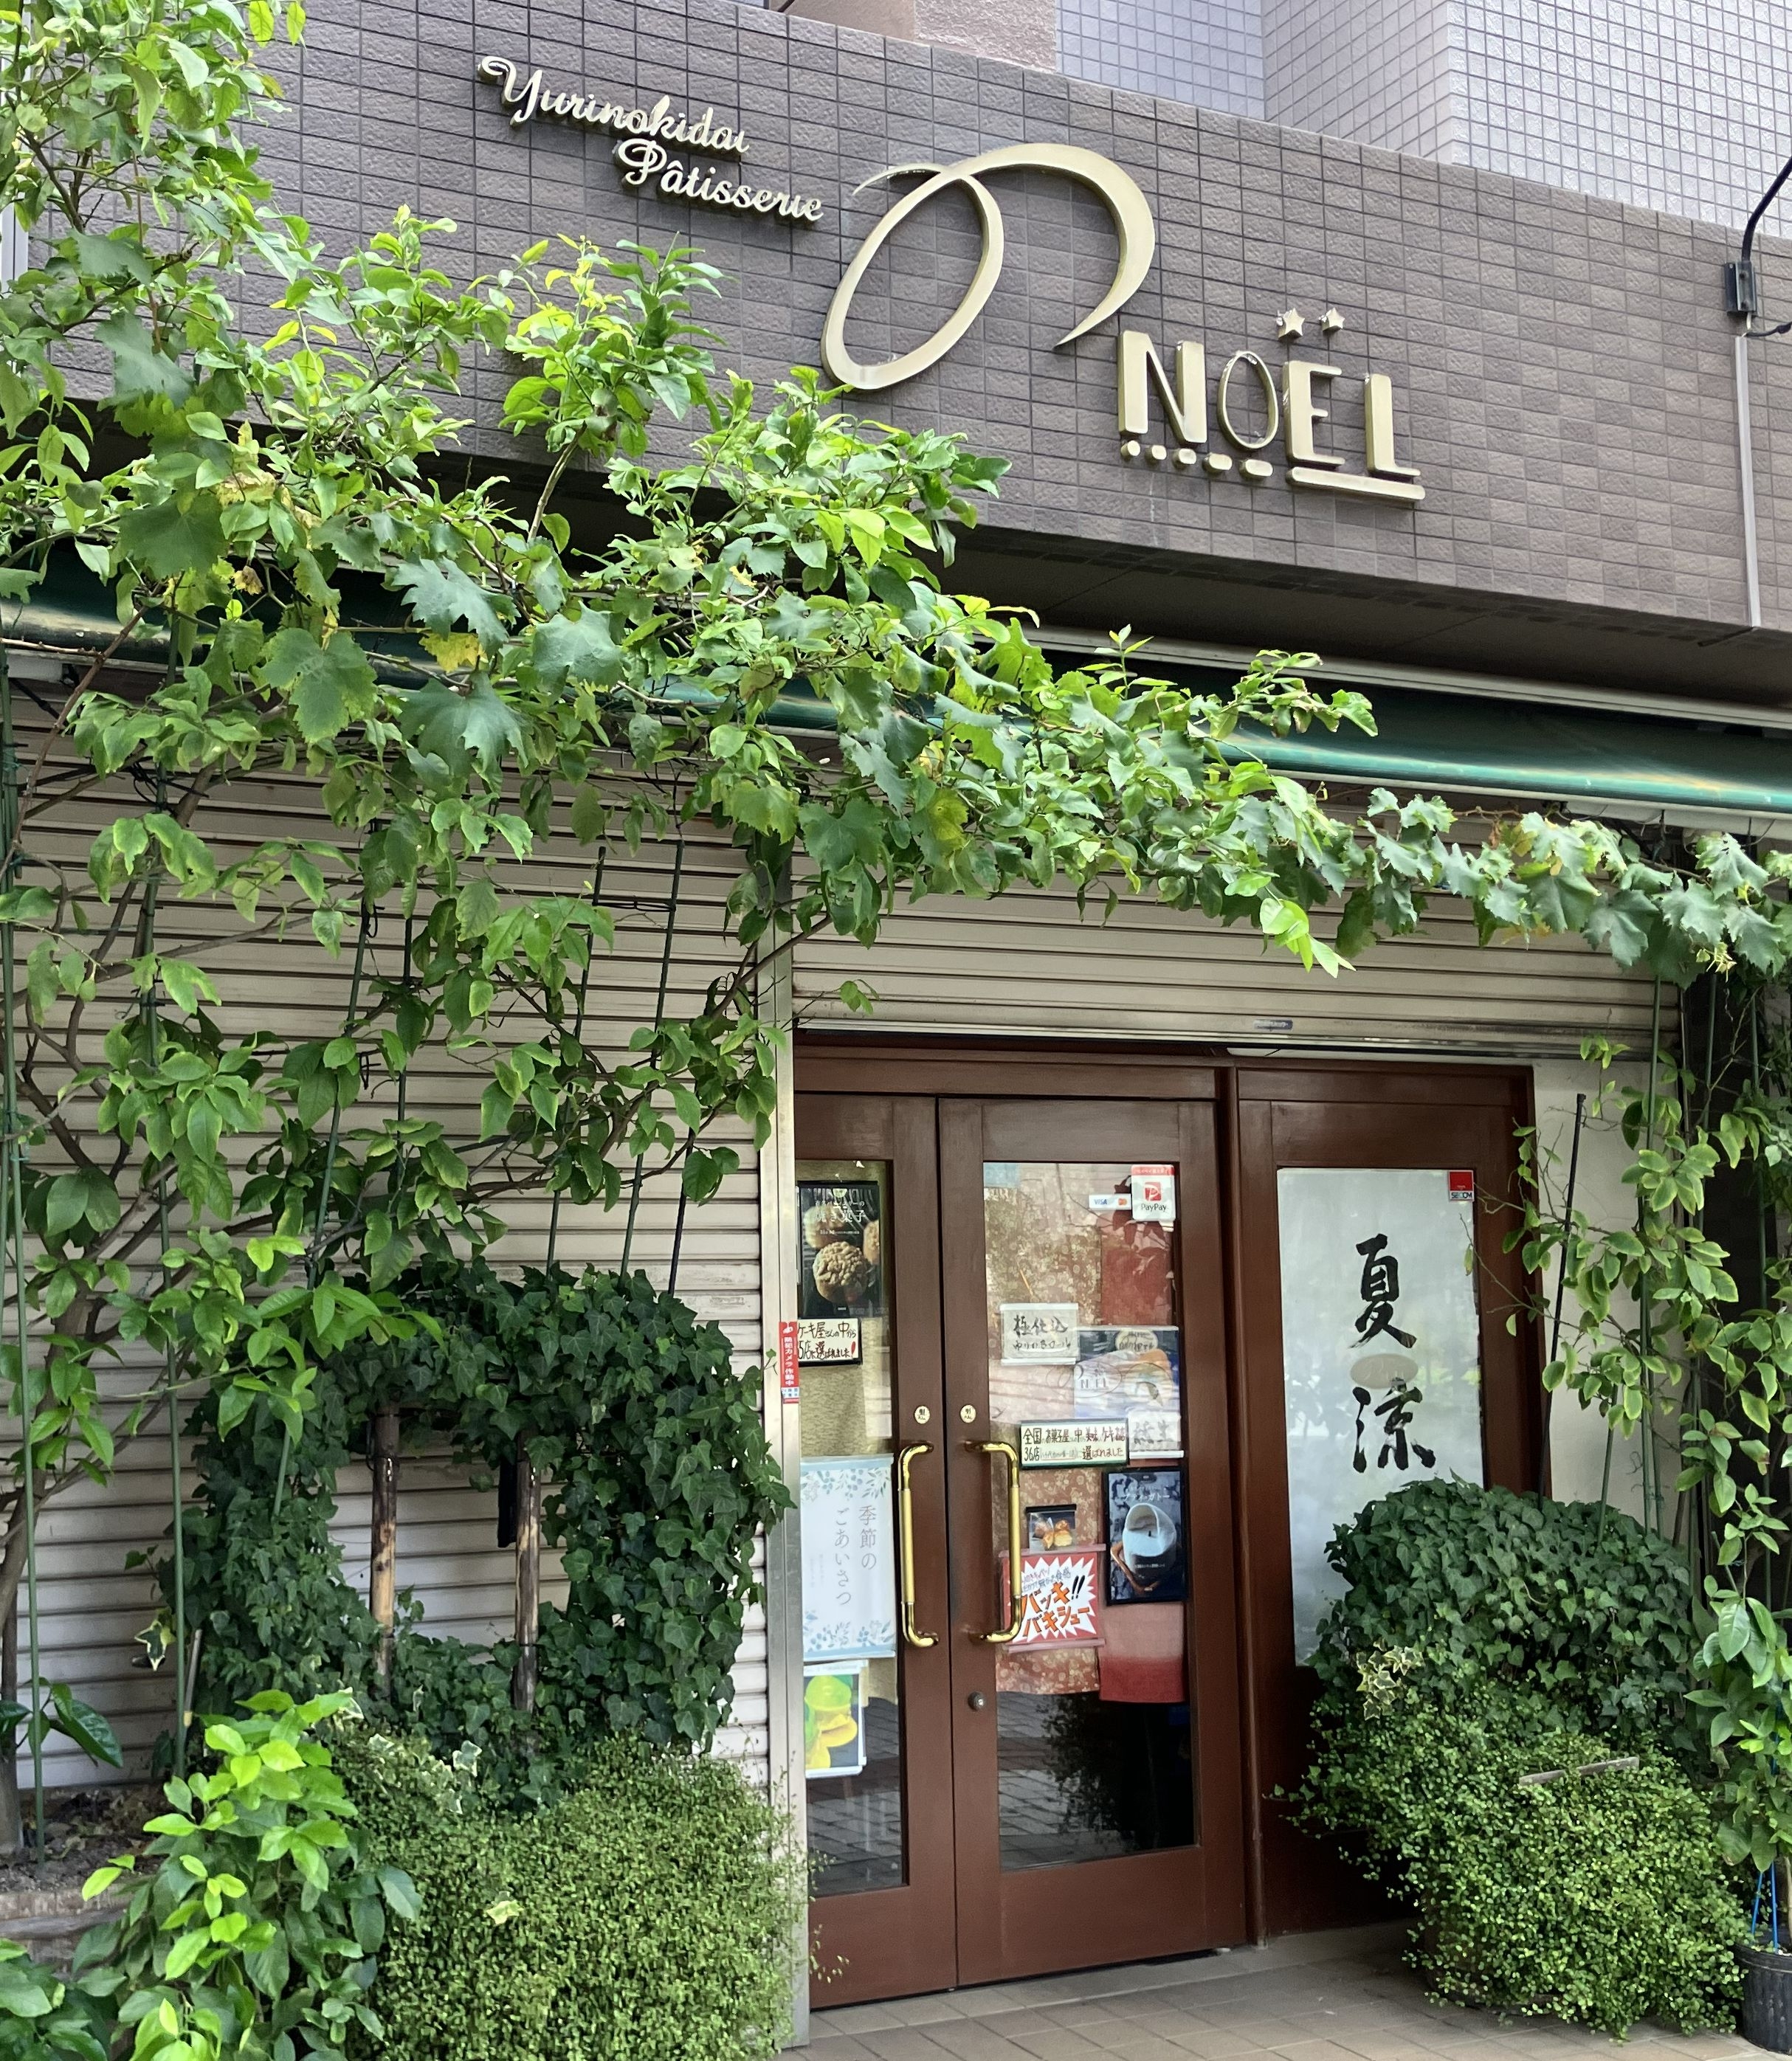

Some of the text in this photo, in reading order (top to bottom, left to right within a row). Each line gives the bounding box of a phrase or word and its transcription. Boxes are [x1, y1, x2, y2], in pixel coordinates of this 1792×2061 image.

[613, 138, 824, 222] Pâtisserie
[1141, 1204, 1167, 1212] PayPay
[834, 1508, 852, 1606] ごあいさつ
[858, 1505, 877, 1570] 季節の
